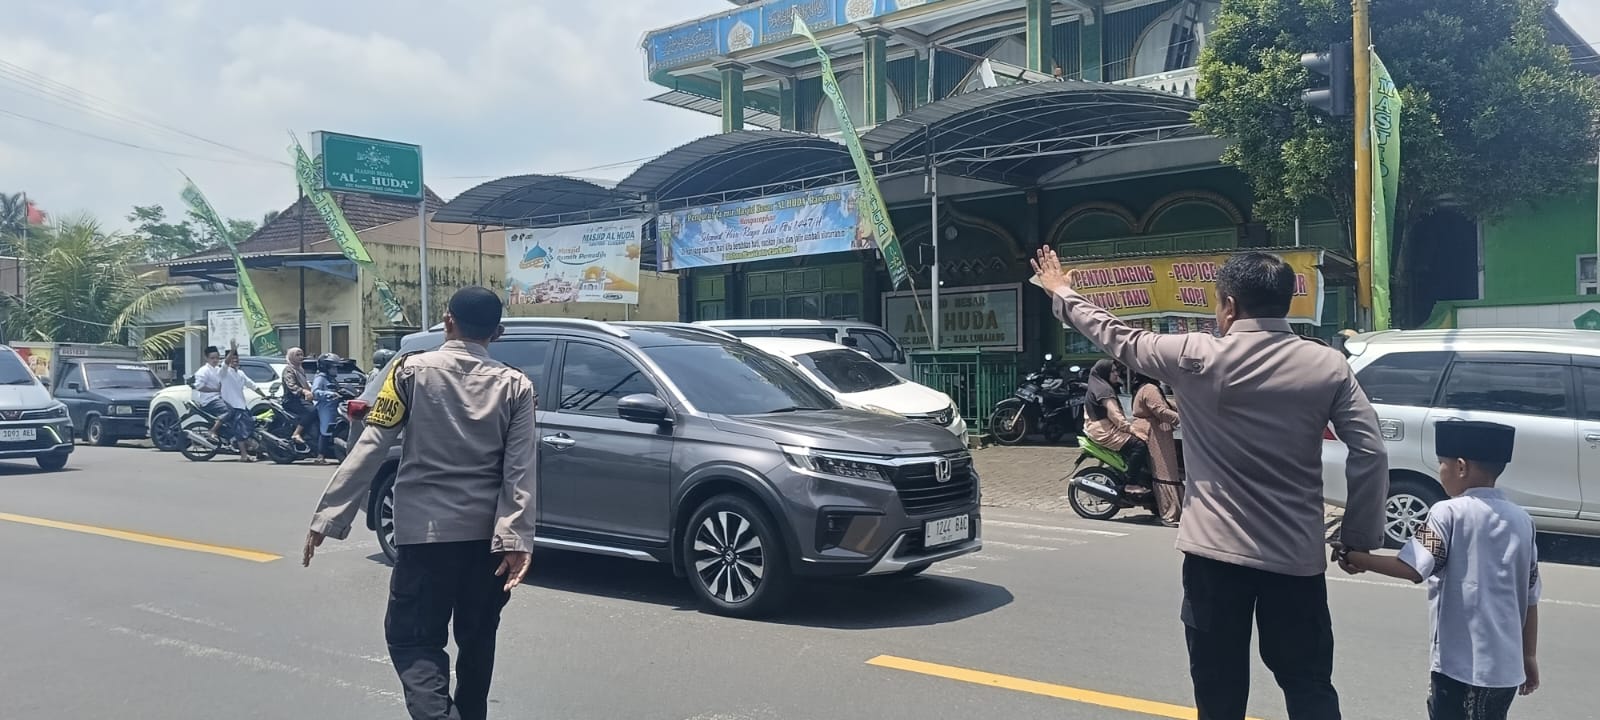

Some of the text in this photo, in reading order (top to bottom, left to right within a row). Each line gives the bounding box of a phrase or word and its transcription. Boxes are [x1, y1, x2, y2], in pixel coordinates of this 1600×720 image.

[1112, 264, 1157, 286] DAGING
[1119, 288, 1152, 308] TAHU
[943, 309, 999, 331] HUDA
[936, 520, 951, 535] 1244
